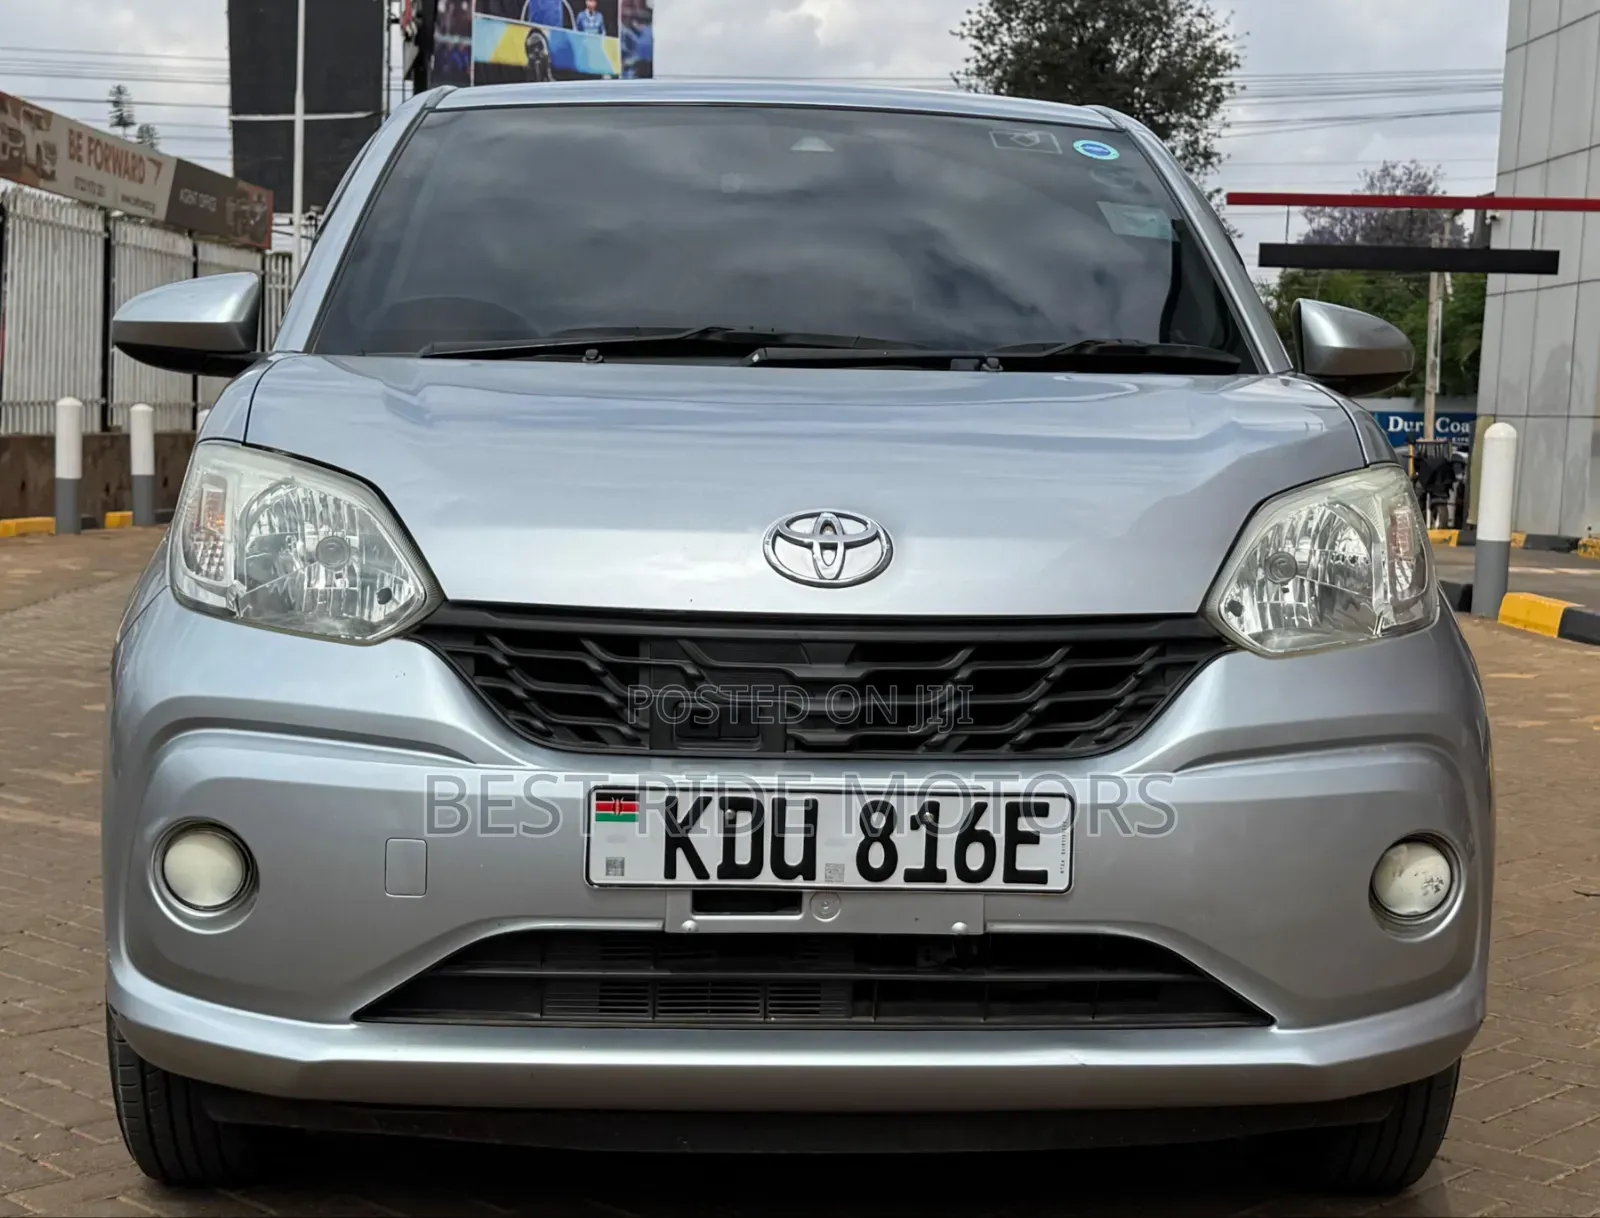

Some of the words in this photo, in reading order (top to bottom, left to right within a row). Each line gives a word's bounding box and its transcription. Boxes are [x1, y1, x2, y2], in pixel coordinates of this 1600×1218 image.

[68, 128, 83, 164] BE
[87, 135, 146, 185] FORWARD
[663, 795, 818, 881] KDU
[856, 800, 1050, 885] 816E
